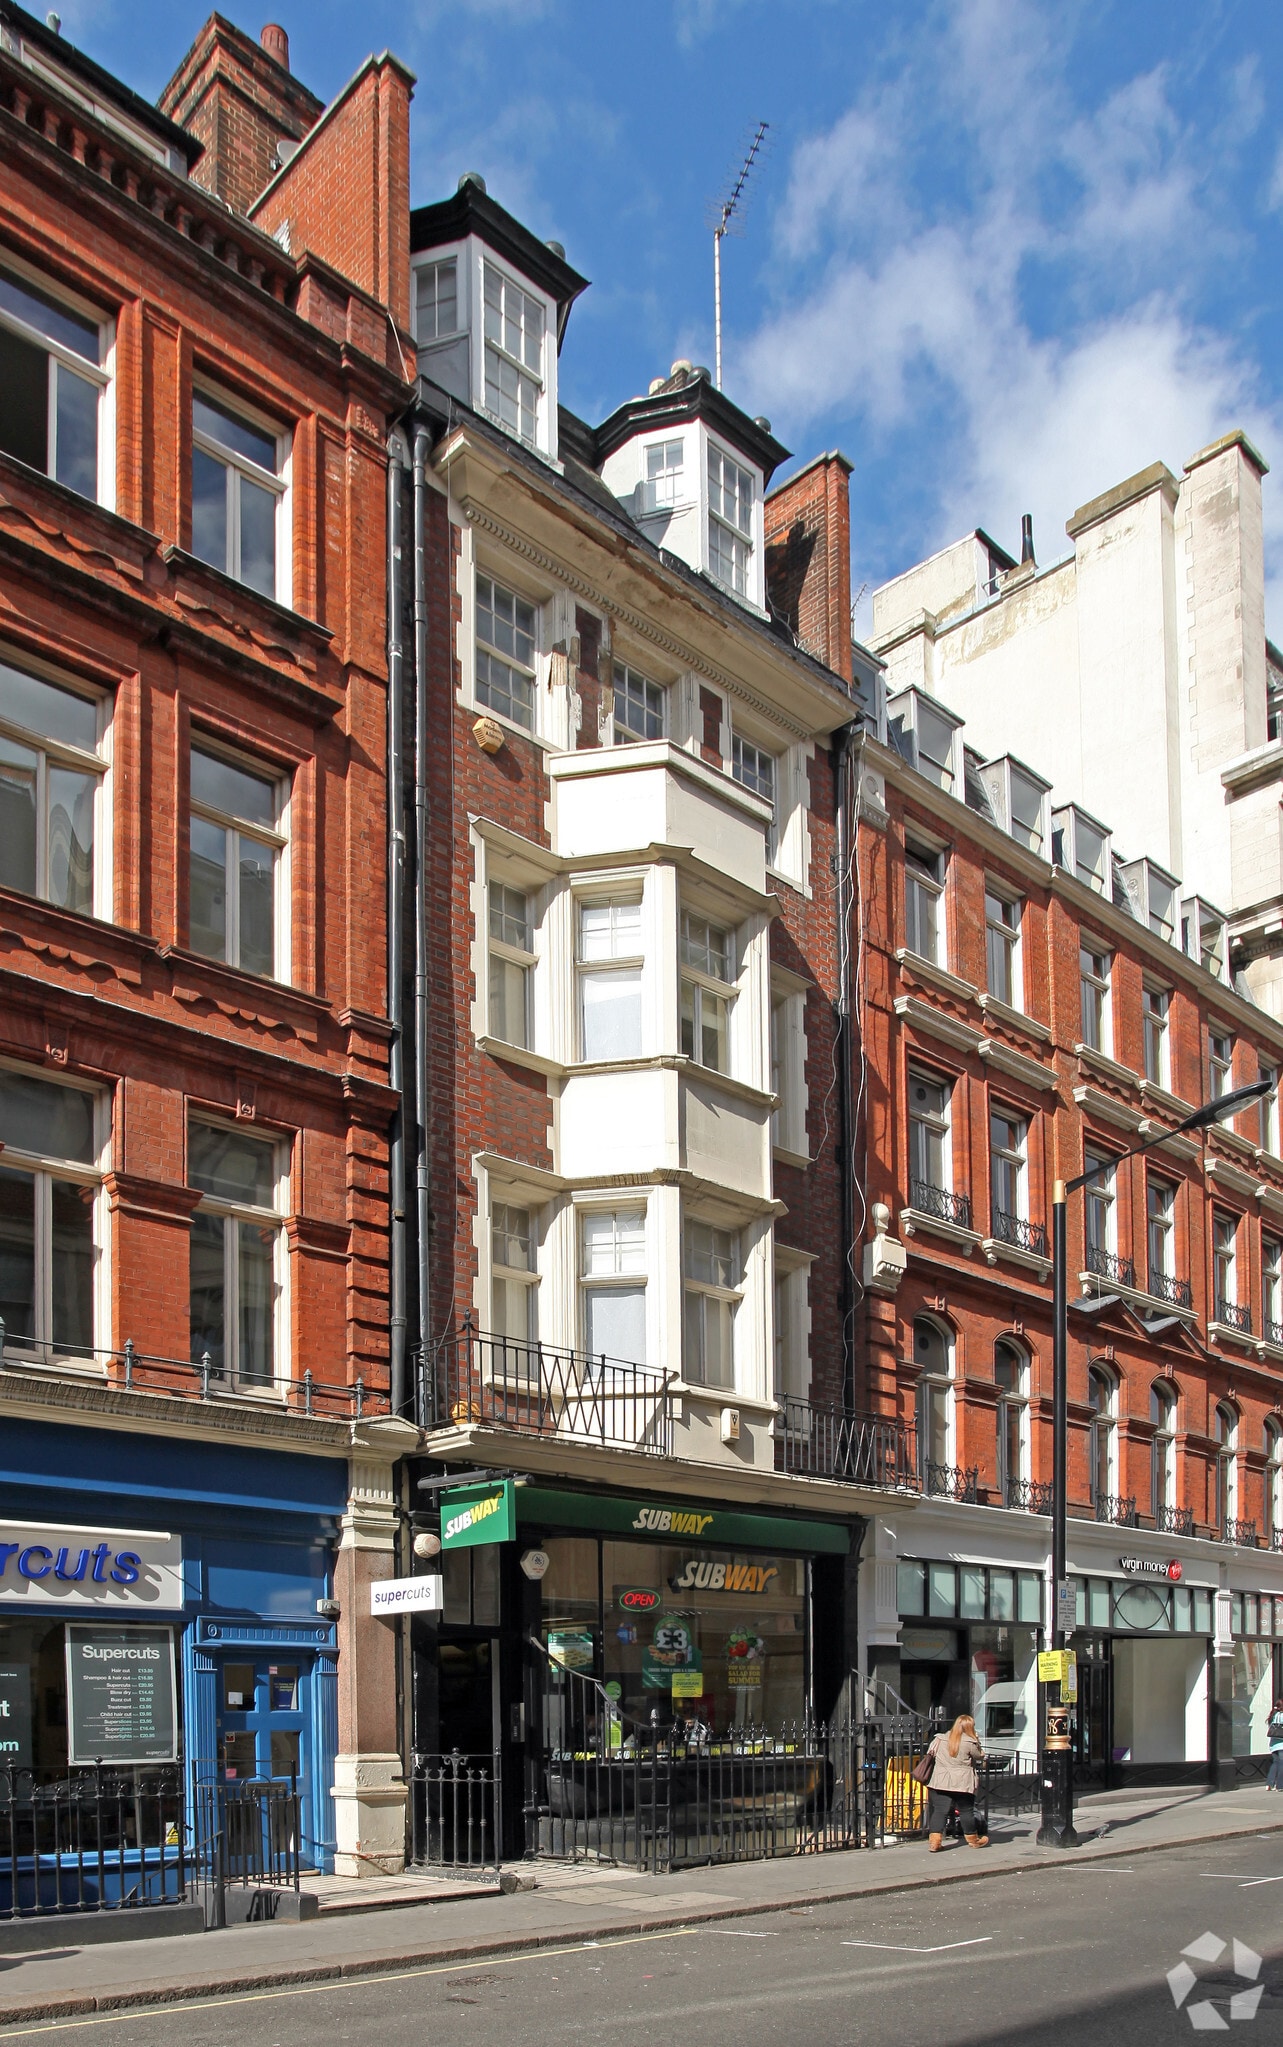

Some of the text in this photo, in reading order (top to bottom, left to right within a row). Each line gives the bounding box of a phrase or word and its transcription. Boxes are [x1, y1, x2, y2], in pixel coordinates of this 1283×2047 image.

[444, 1491, 504, 1540] SUBWAY
[632, 1508, 714, 1535] SUBWAY
[677, 1561, 779, 1592] SUBWAY
[1121, 1556, 1169, 1576] virgin money
[374, 1584, 432, 1605] supercuts
[624, 1592, 656, 1606] OPEN
[656, 1628, 688, 1650] £3
[82, 1645, 160, 1661] Supercuts
